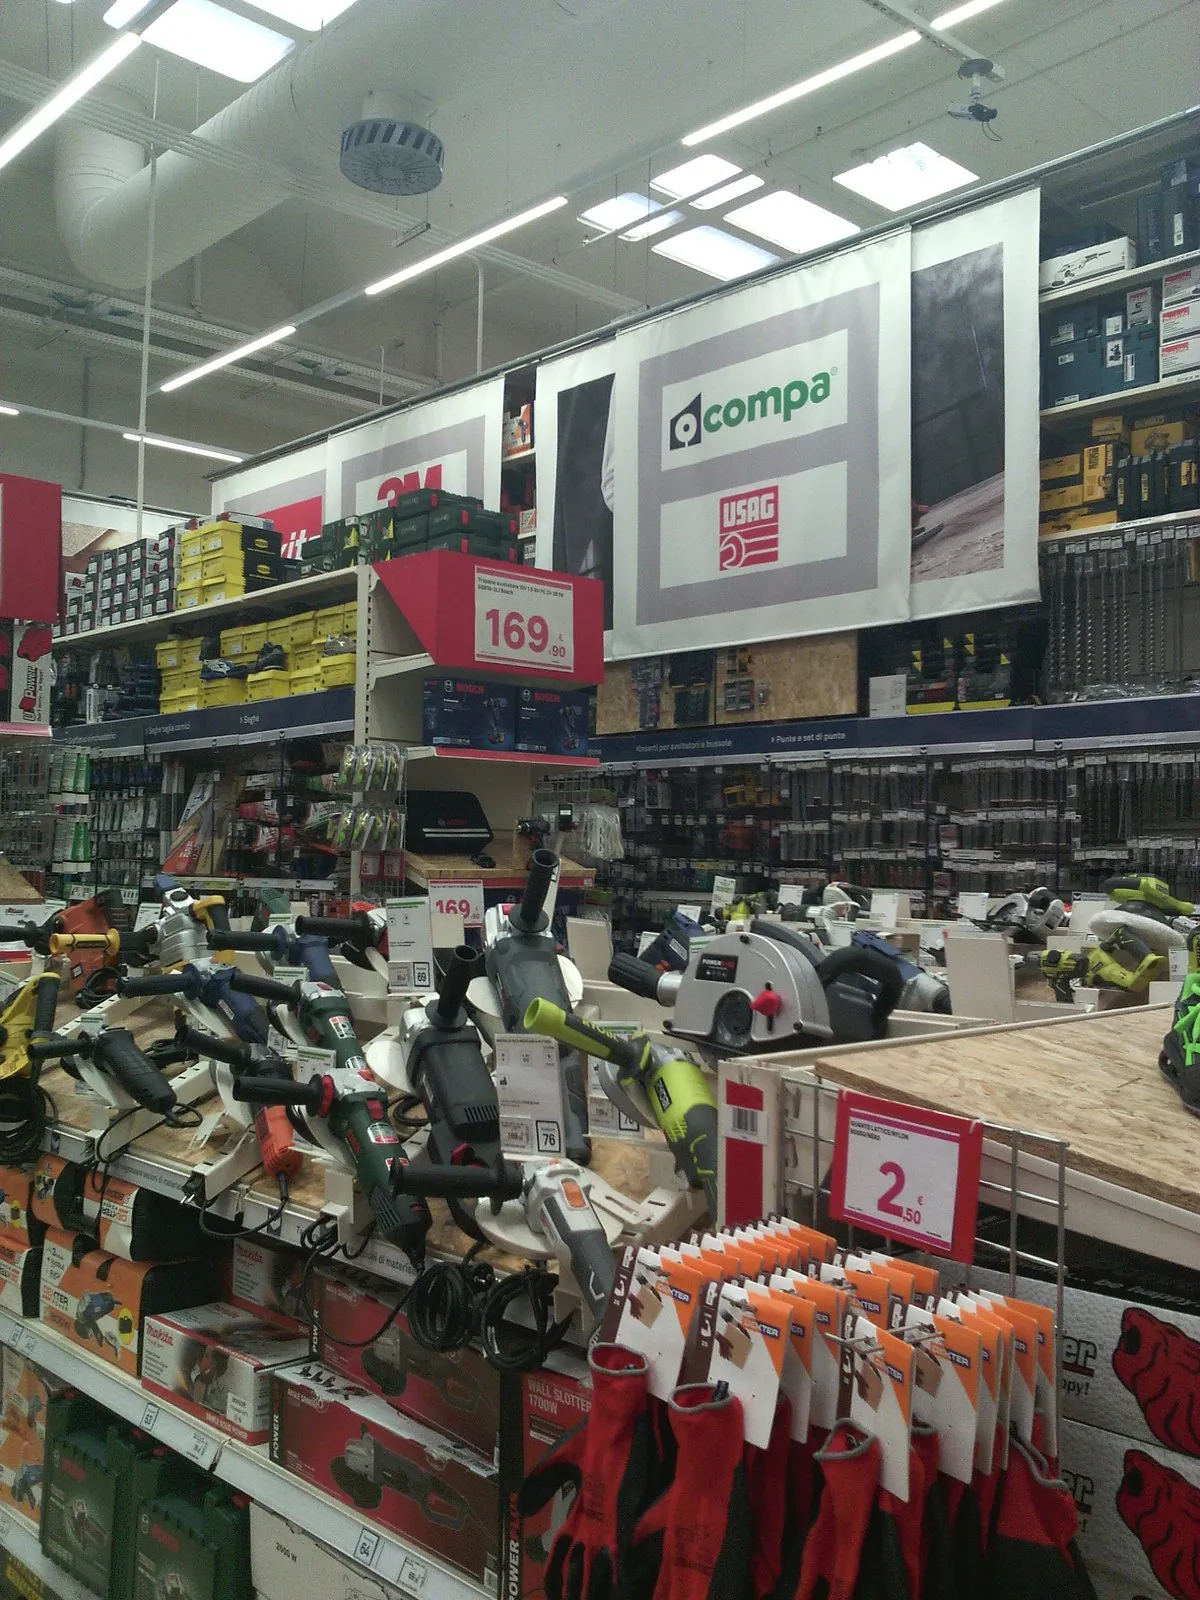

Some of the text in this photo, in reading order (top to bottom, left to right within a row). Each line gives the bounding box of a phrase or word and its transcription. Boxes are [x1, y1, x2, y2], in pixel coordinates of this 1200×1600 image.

[703, 372, 830, 433] compa
[723, 492, 775, 528] USAG
[486, 608, 549, 653] 169
[776, 735, 796, 743] Punte
[803, 733, 815, 741] set
[815, 732, 823, 740] di
[824, 731, 846, 741] punte
[435, 899, 470, 919] 169
[417, 972, 427, 982] 69
[542, 1133, 556, 1146] 76
[877, 1161, 905, 1218] 2
[656, 1279, 691, 1304] DEXTER
[742, 1315, 781, 1340] DEXTER
[528, 1379, 552, 1398] WALL
[529, 1394, 558, 1415] 1700W
[272, 1413, 280, 1459] POWER
